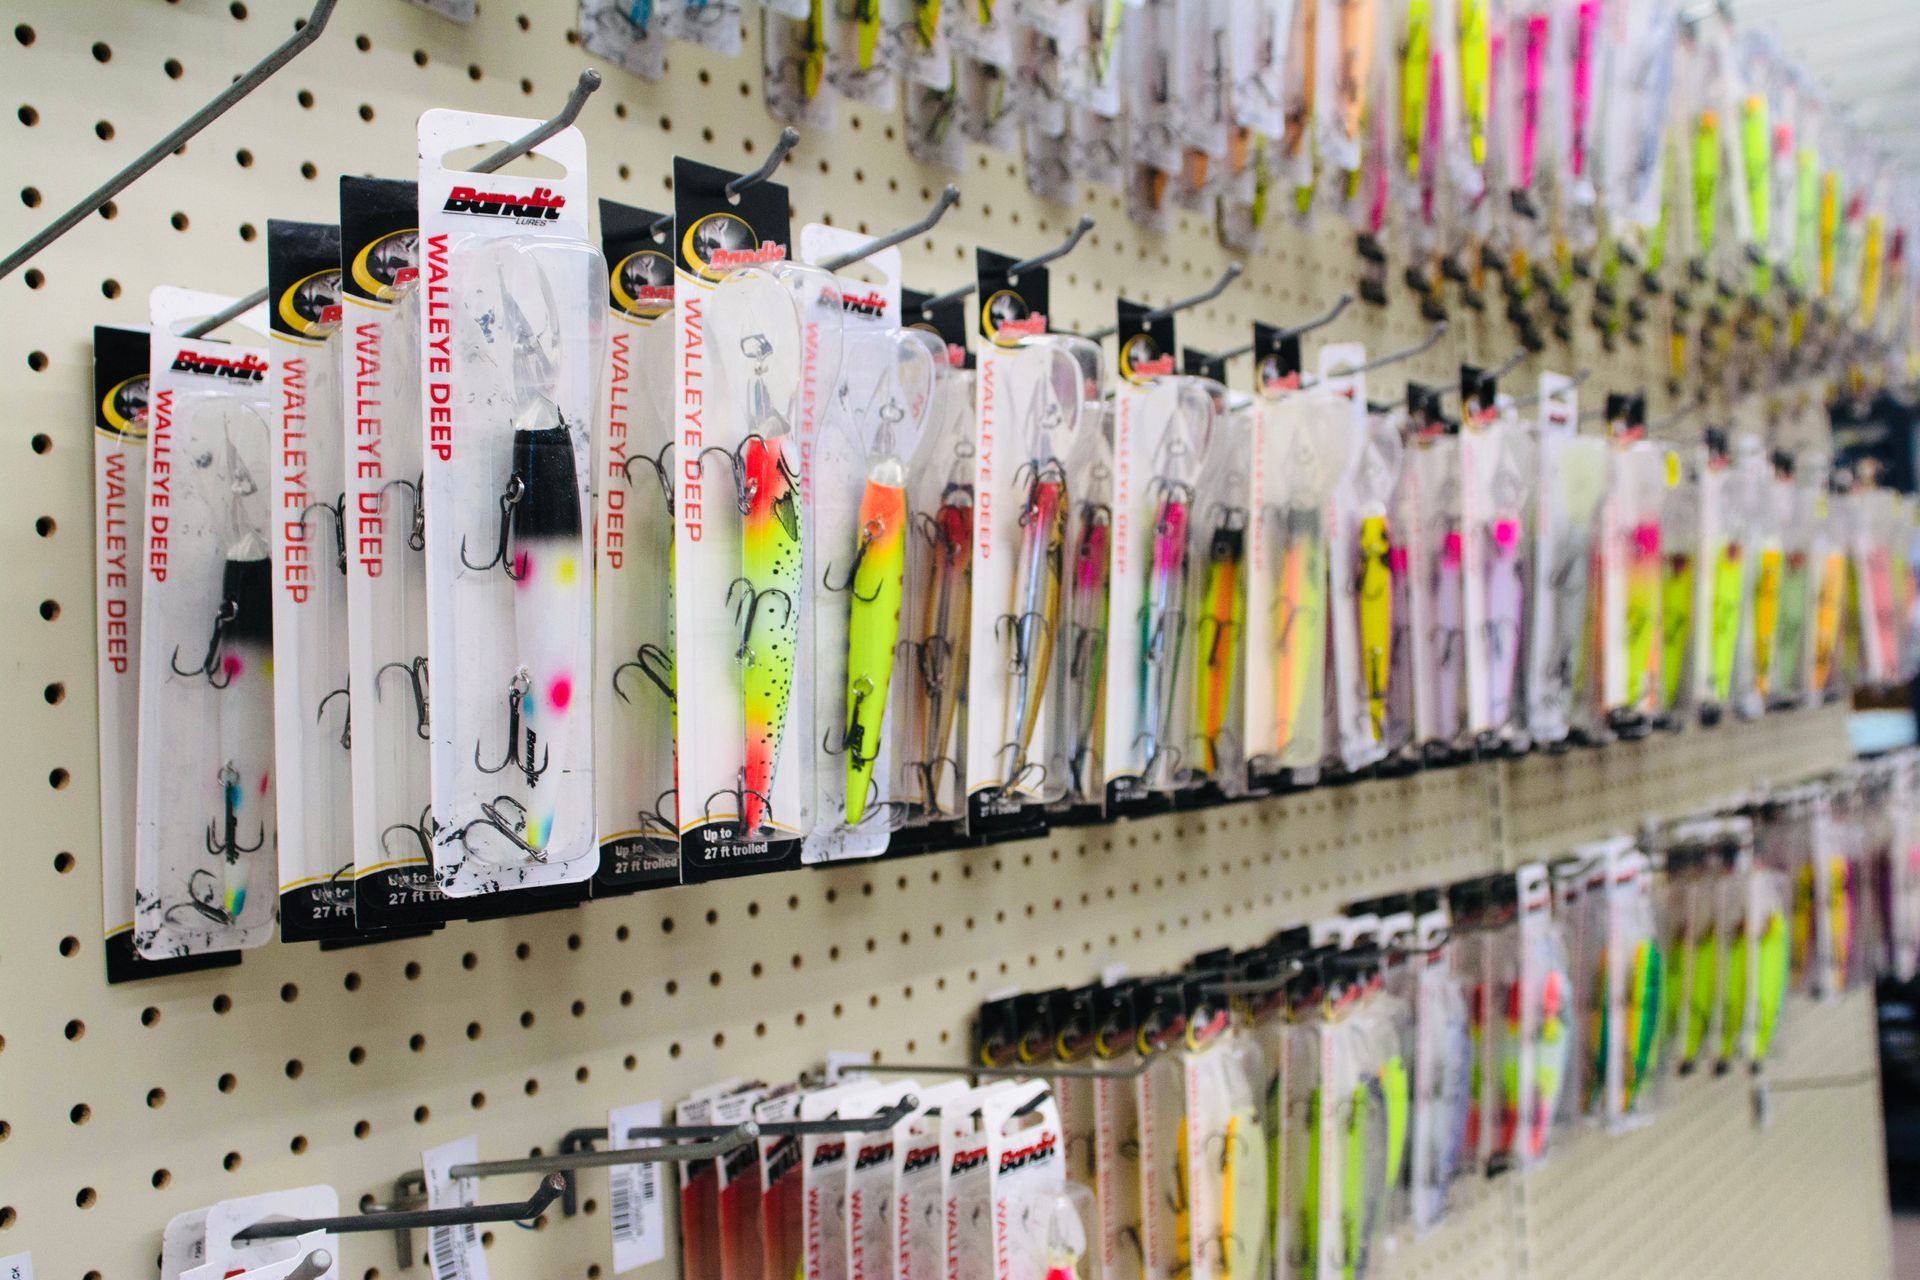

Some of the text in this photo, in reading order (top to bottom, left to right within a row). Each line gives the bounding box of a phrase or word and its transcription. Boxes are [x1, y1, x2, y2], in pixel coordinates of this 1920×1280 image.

[443, 186, 566, 219] Bandit
[516, 218, 547, 226] LURES
[427, 234, 452, 461] WALLEYE DEEP
[171, 350, 268, 381] Bandit
[684, 298, 703, 543] WALLEYE DEEP
[356, 322, 382, 577] WALLEYE DEEP
[607, 334, 629, 570] WALLEYE DEEP
[150, 390, 173, 583] WALLEYE DEEP
[283, 358, 308, 604] WALLEYE DEEP
[105, 453, 128, 674] WALLEYE DEEP
[615, 843, 643, 858] Up to
[703, 827, 732, 842] Up to
[615, 857, 678, 874] 27 ft trolled
[704, 842, 768, 860] 27 ft trolled
[313, 907, 331, 918] 27
[389, 893, 407, 905] 27
[412, 890, 425, 902] ft
